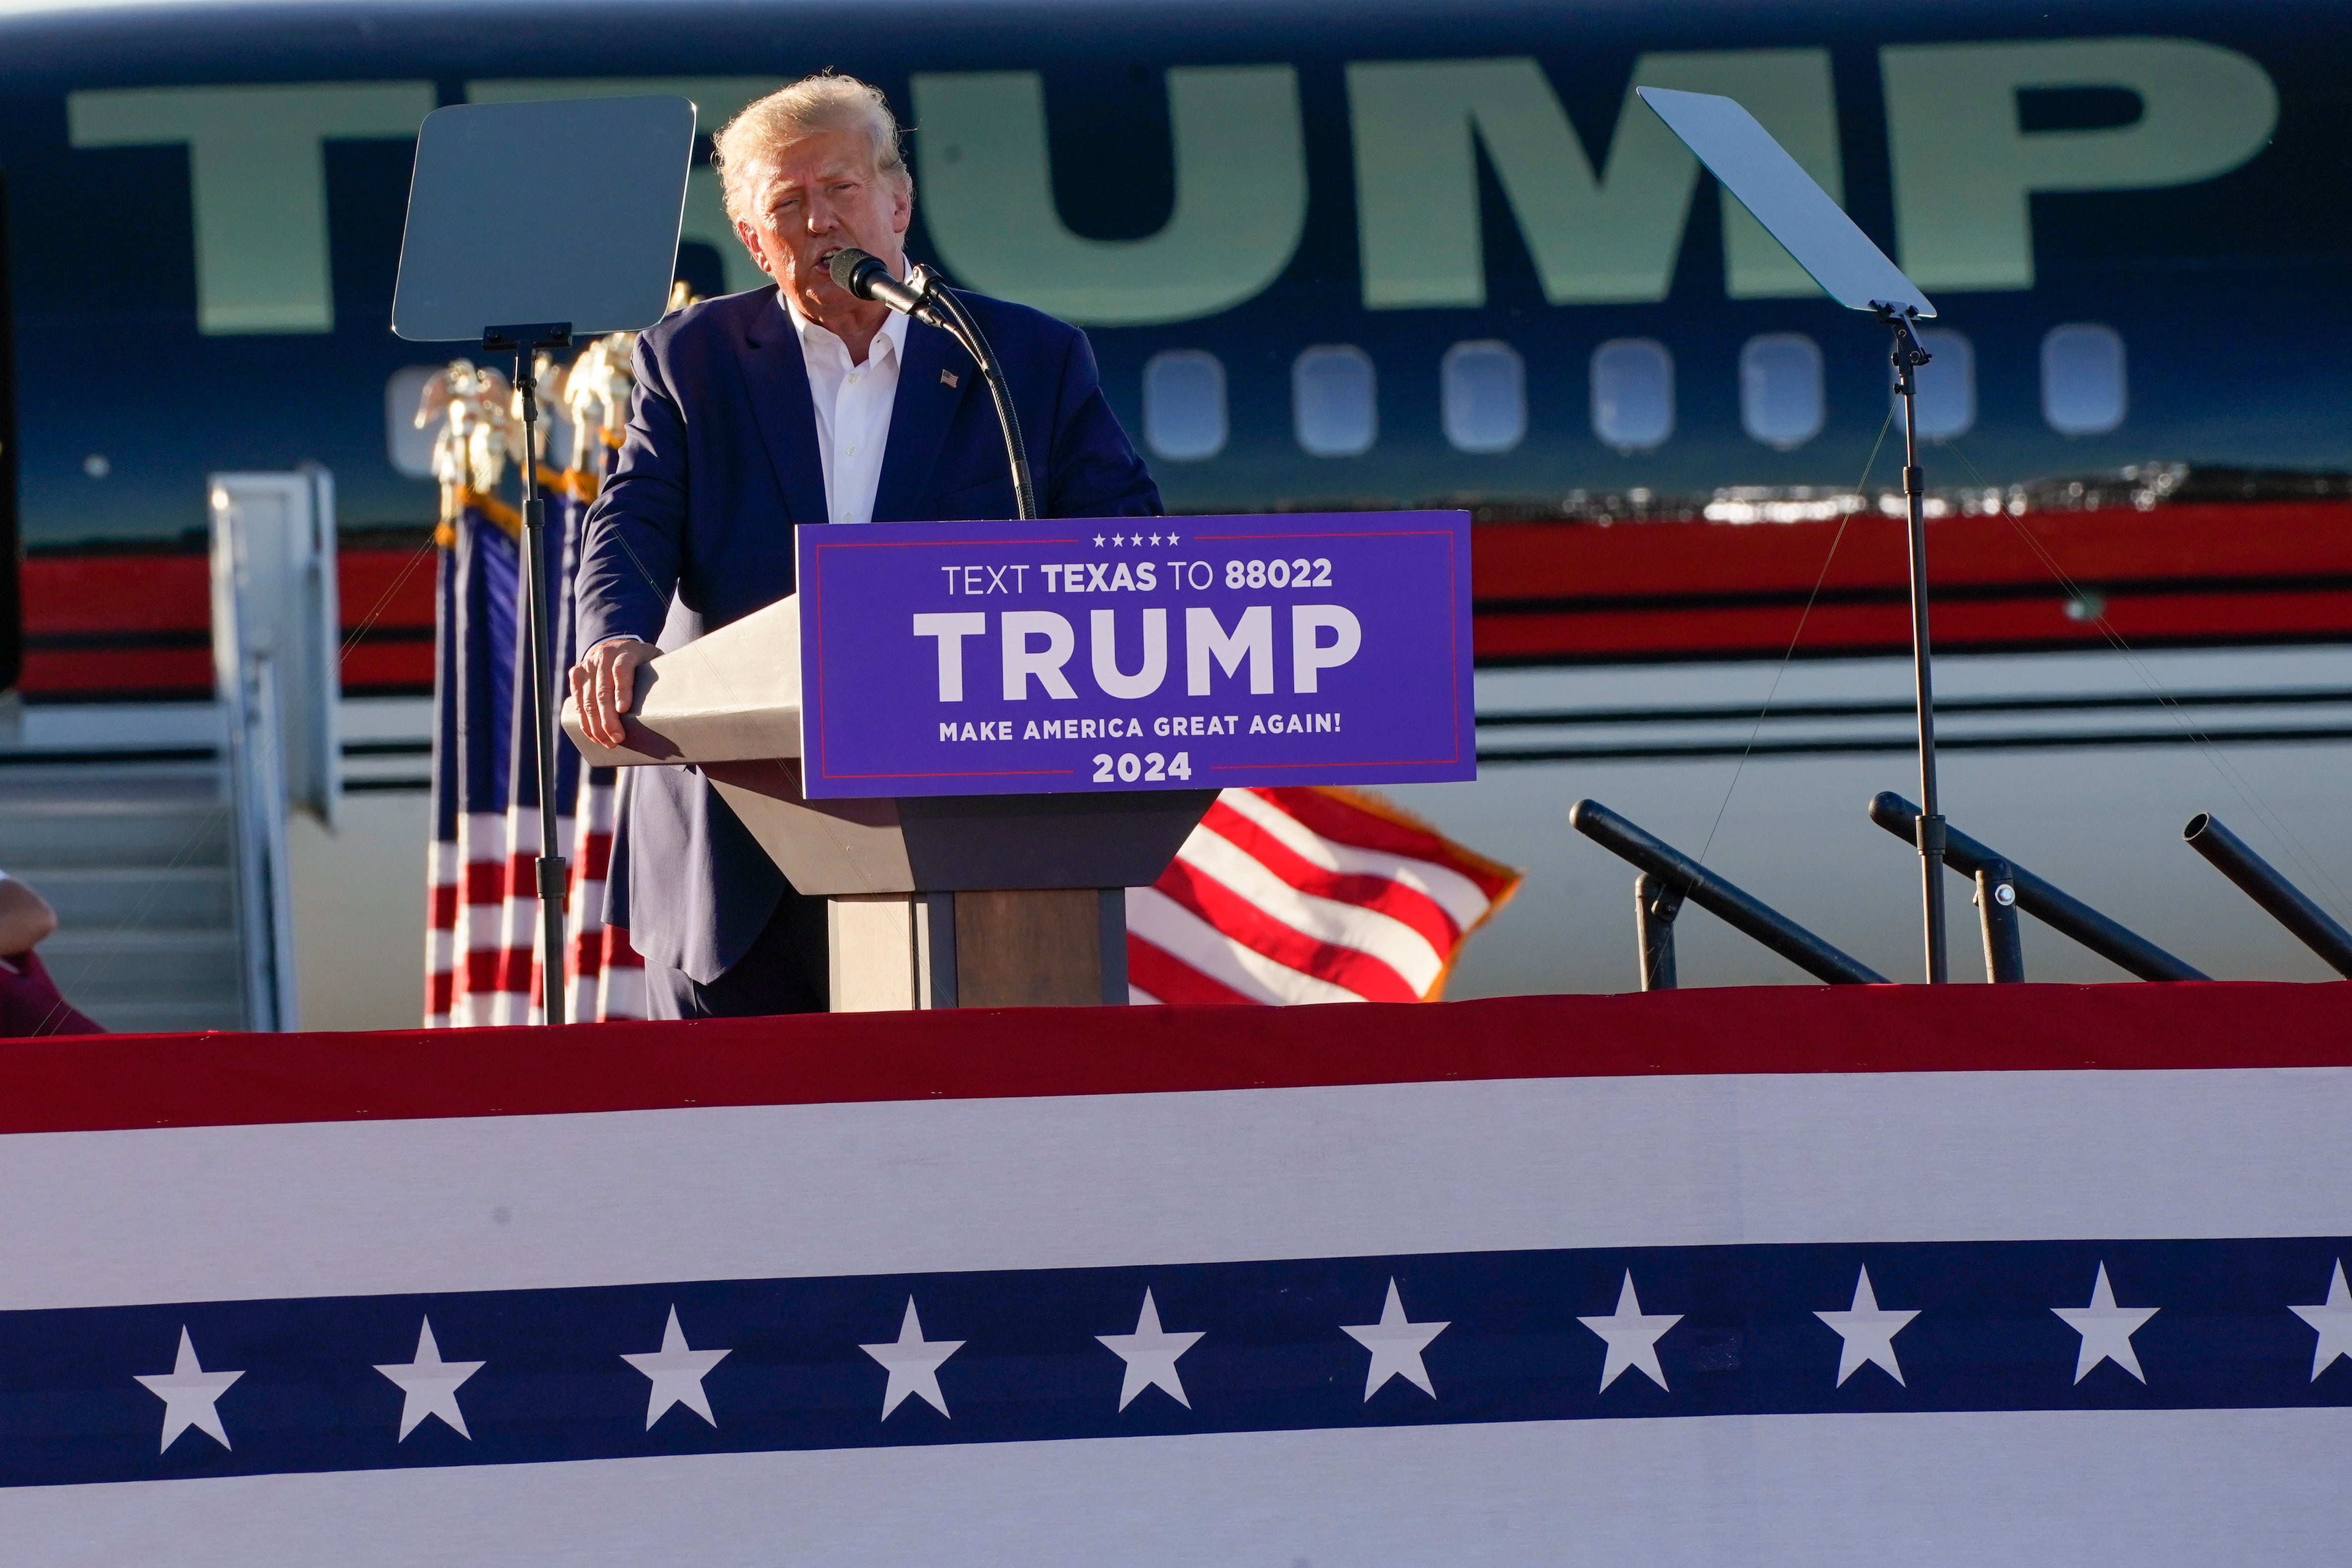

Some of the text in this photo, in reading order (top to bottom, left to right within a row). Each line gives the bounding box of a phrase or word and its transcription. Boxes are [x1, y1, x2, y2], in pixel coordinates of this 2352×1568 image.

[941, 558, 1332, 595] TEXT TEXAS TO 88022
[913, 604, 1362, 702] TRUMP
[939, 713, 1340, 742] MAKE AMERICA GREAT AGAIN!
[1092, 752, 1192, 783] 2024
